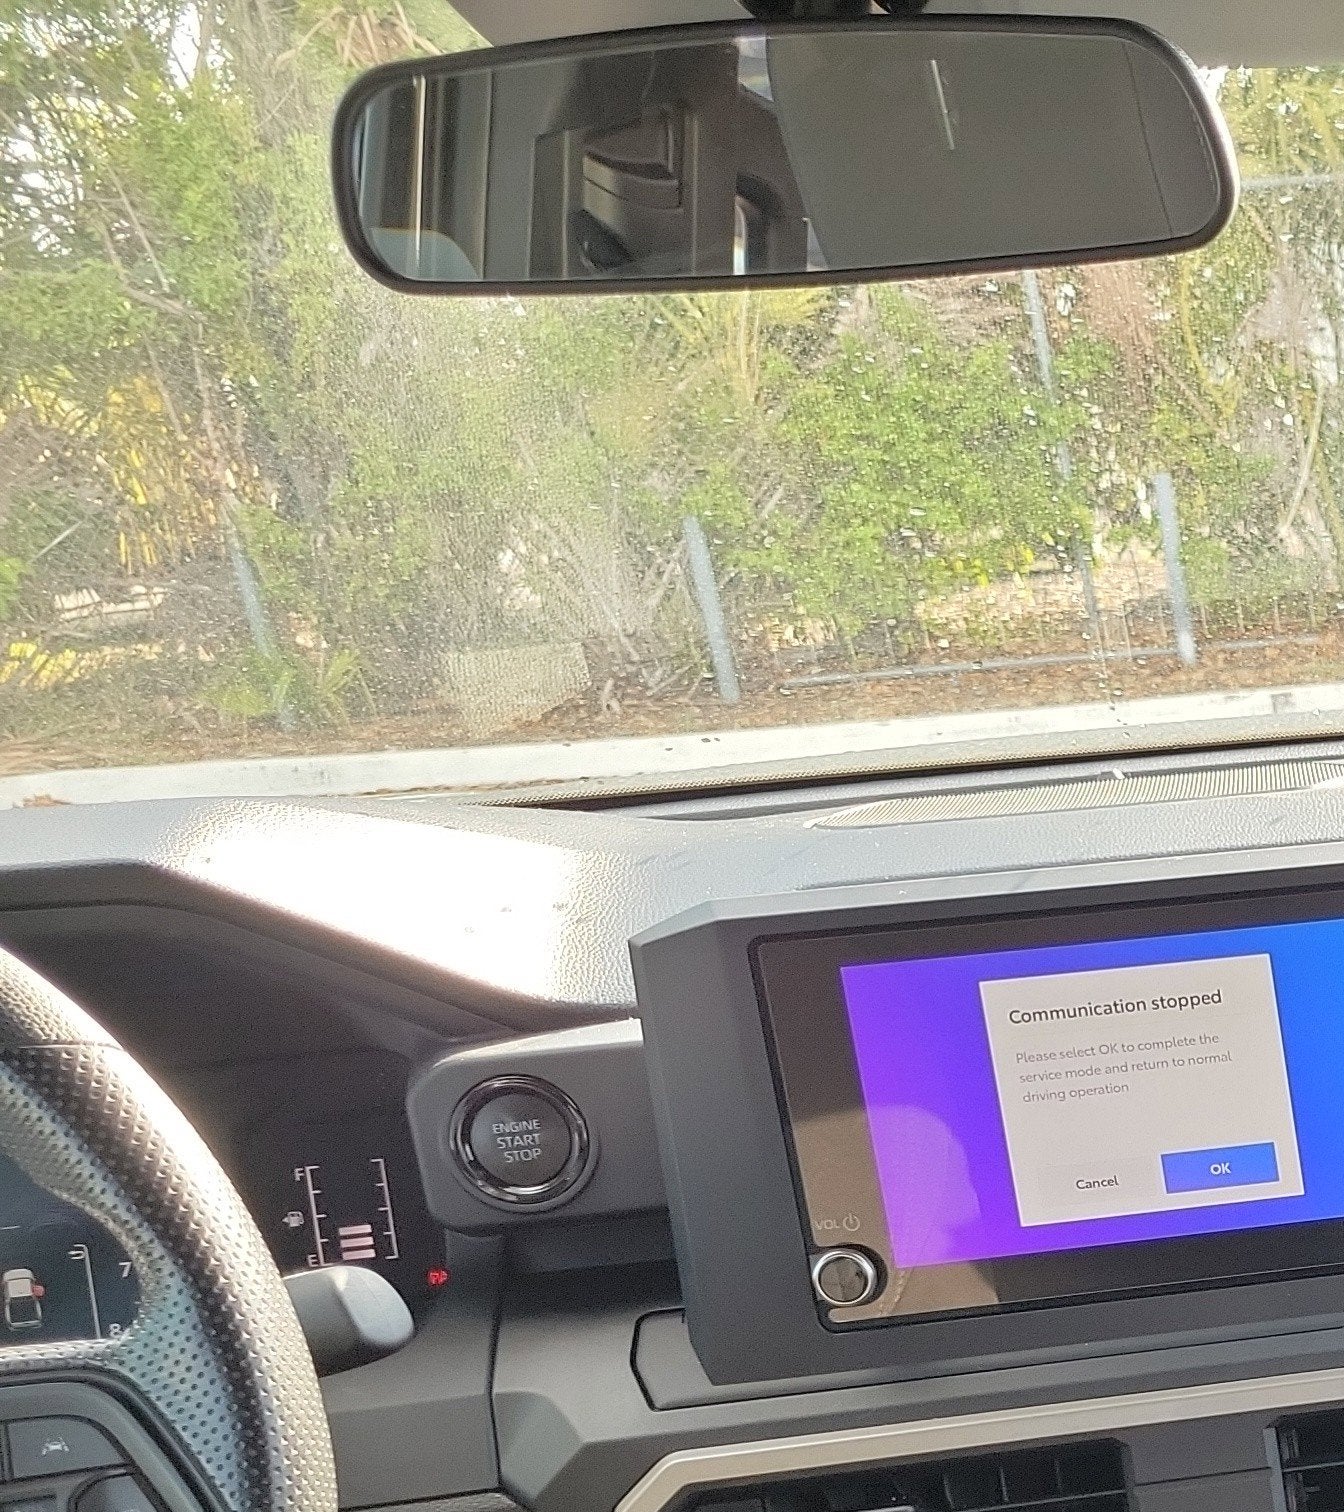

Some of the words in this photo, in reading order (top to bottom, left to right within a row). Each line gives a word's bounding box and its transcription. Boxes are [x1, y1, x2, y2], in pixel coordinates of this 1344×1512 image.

[1008, 998, 1147, 1025] Communication
[1151, 988, 1223, 1012] stopped
[1016, 1050, 1057, 1065] Please
[1059, 1045, 1096, 1059] select
[1099, 1042, 1119, 1056] OK
[1121, 1041, 1135, 1054] to
[1137, 1037, 1196, 1053] complete
[1199, 1032, 1219, 1045] the
[1019, 1069, 1062, 1084] service
[1065, 1065, 1101, 1080] mode
[1104, 1062, 1128, 1076] and
[1131, 1058, 1169, 1072] return
[1172, 1056, 1185, 1068] to
[1188, 1051, 1233, 1067] normal
[1022, 1089, 1066, 1104] driving
[1069, 1083, 1129, 1100] operation
[491, 1119, 541, 1134] ENGINE
[496, 1133, 541, 1149] START
[503, 1148, 541, 1163] STOP
[293, 1167, 305, 1182] F
[1210, 1162, 1232, 1176] OK
[1075, 1175, 1120, 1190] Cancel
[812, 1219, 841, 1231] VOL
[307, 1253, 319, 1268] E
[118, 1261, 132, 1278] 7
[108, 1322, 122, 1339] 8
